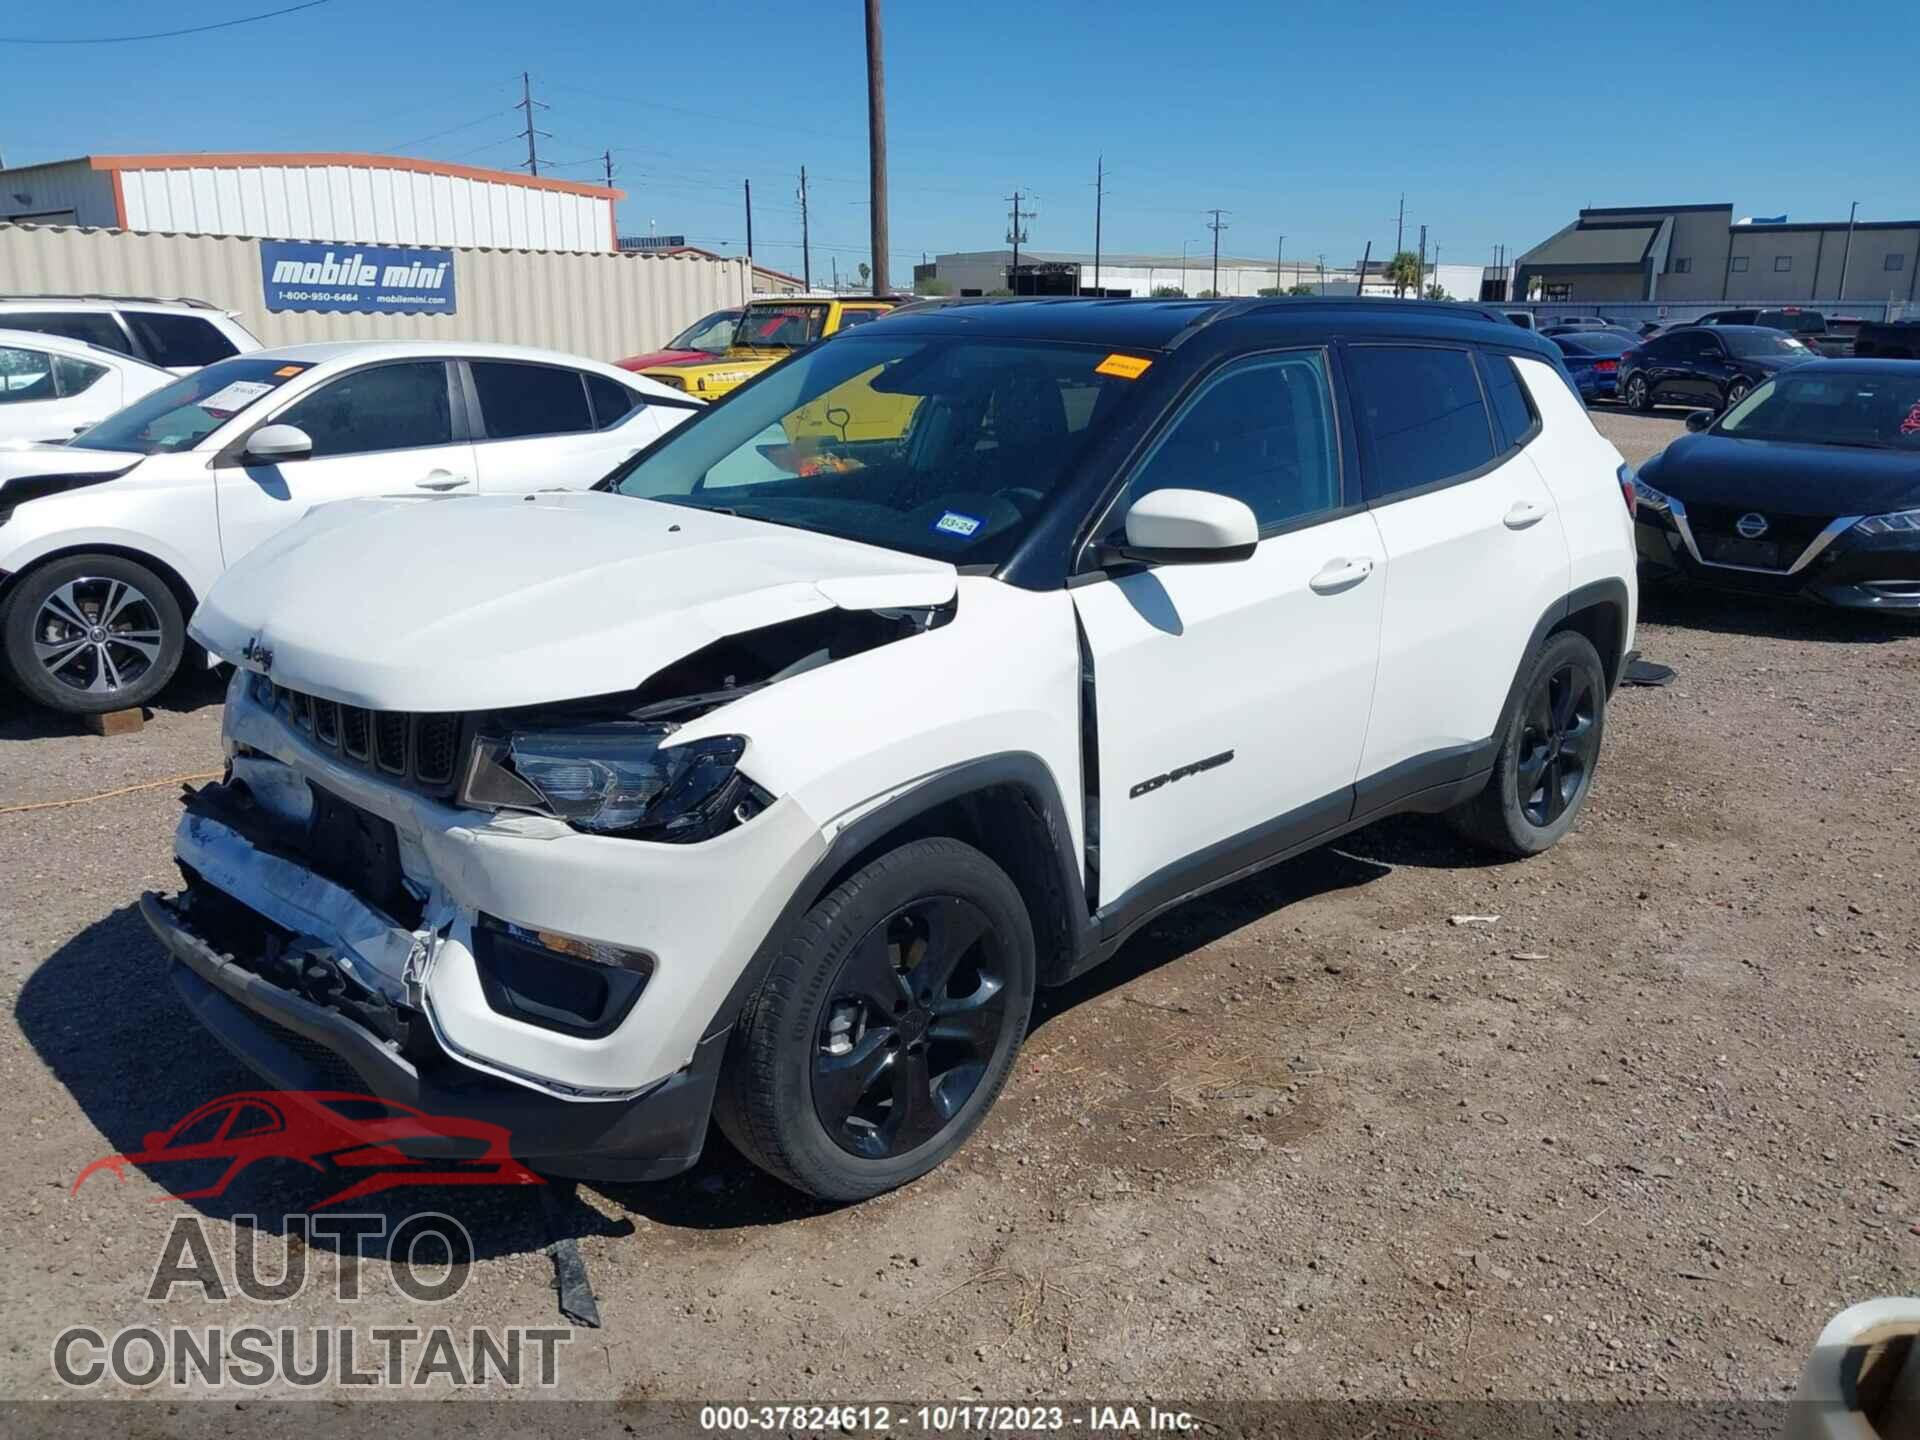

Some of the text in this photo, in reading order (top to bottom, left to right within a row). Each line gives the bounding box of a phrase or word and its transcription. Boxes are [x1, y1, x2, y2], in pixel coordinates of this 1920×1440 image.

[272, 252, 447, 288] mobile mini
[279, 291, 446, 305] 1-800-950-6464 mobilemini.com
